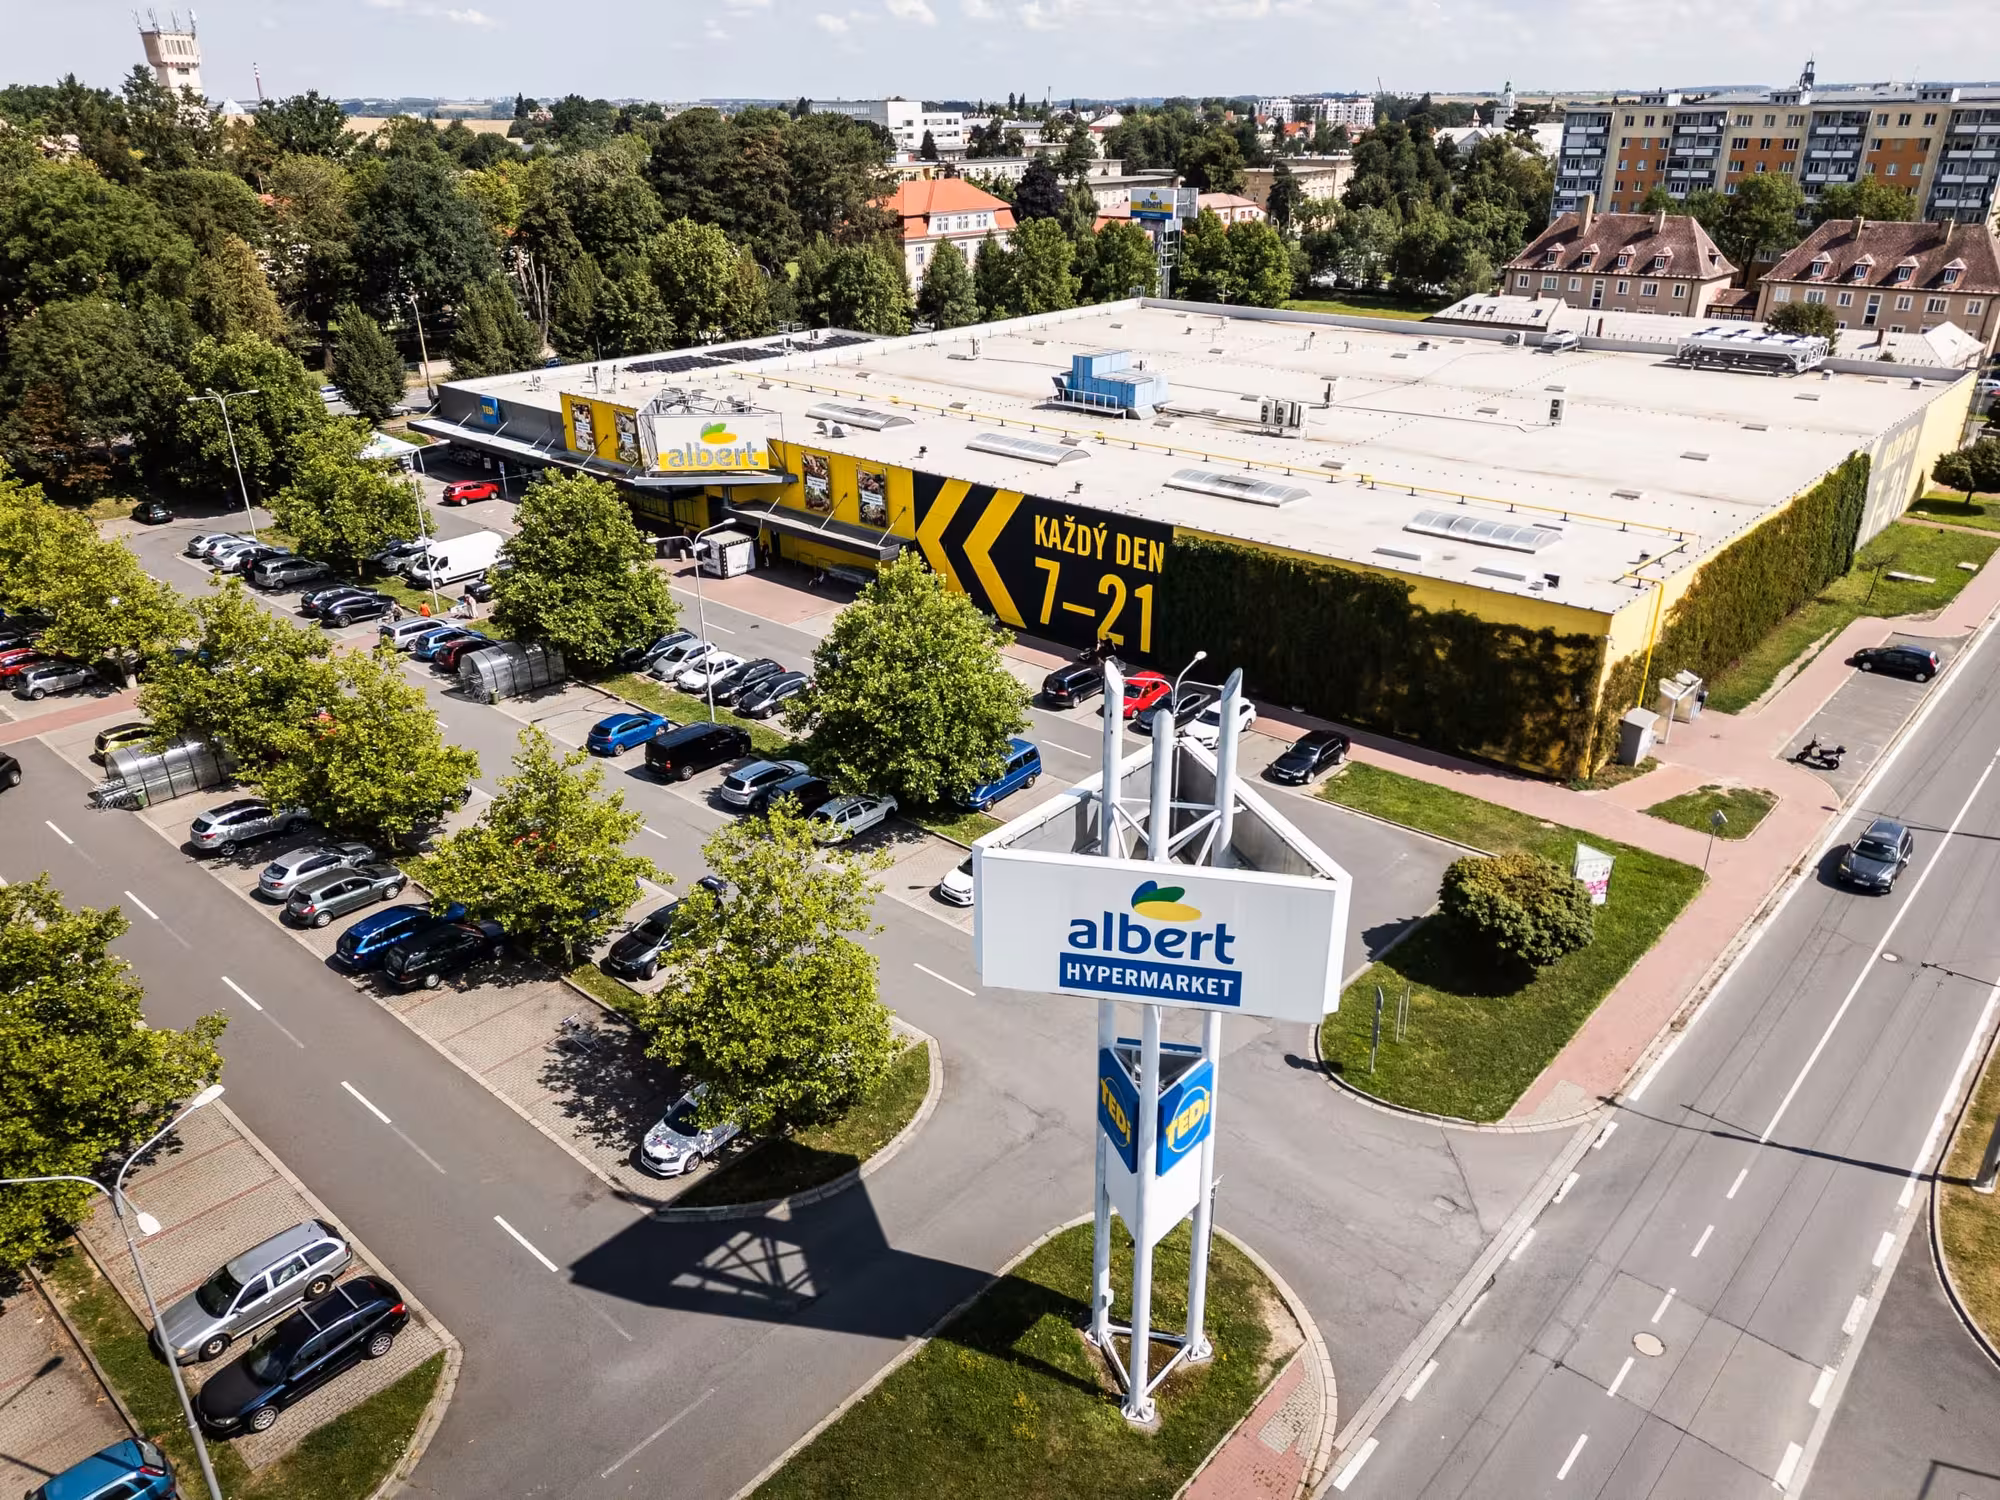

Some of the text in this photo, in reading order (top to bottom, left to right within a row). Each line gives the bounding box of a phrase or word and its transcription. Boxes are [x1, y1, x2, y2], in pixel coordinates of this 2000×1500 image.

[1141, 198, 1164, 209] albert
[668, 441, 759, 467] albert
[1035, 514, 1165, 573] KAŽDÝ DEN
[1068, 911, 1236, 965] albert
[1066, 962, 1234, 997] HYPERMARKET
[1100, 1078, 1131, 1144] TEDi
[1166, 1091, 1210, 1148] TEDi
